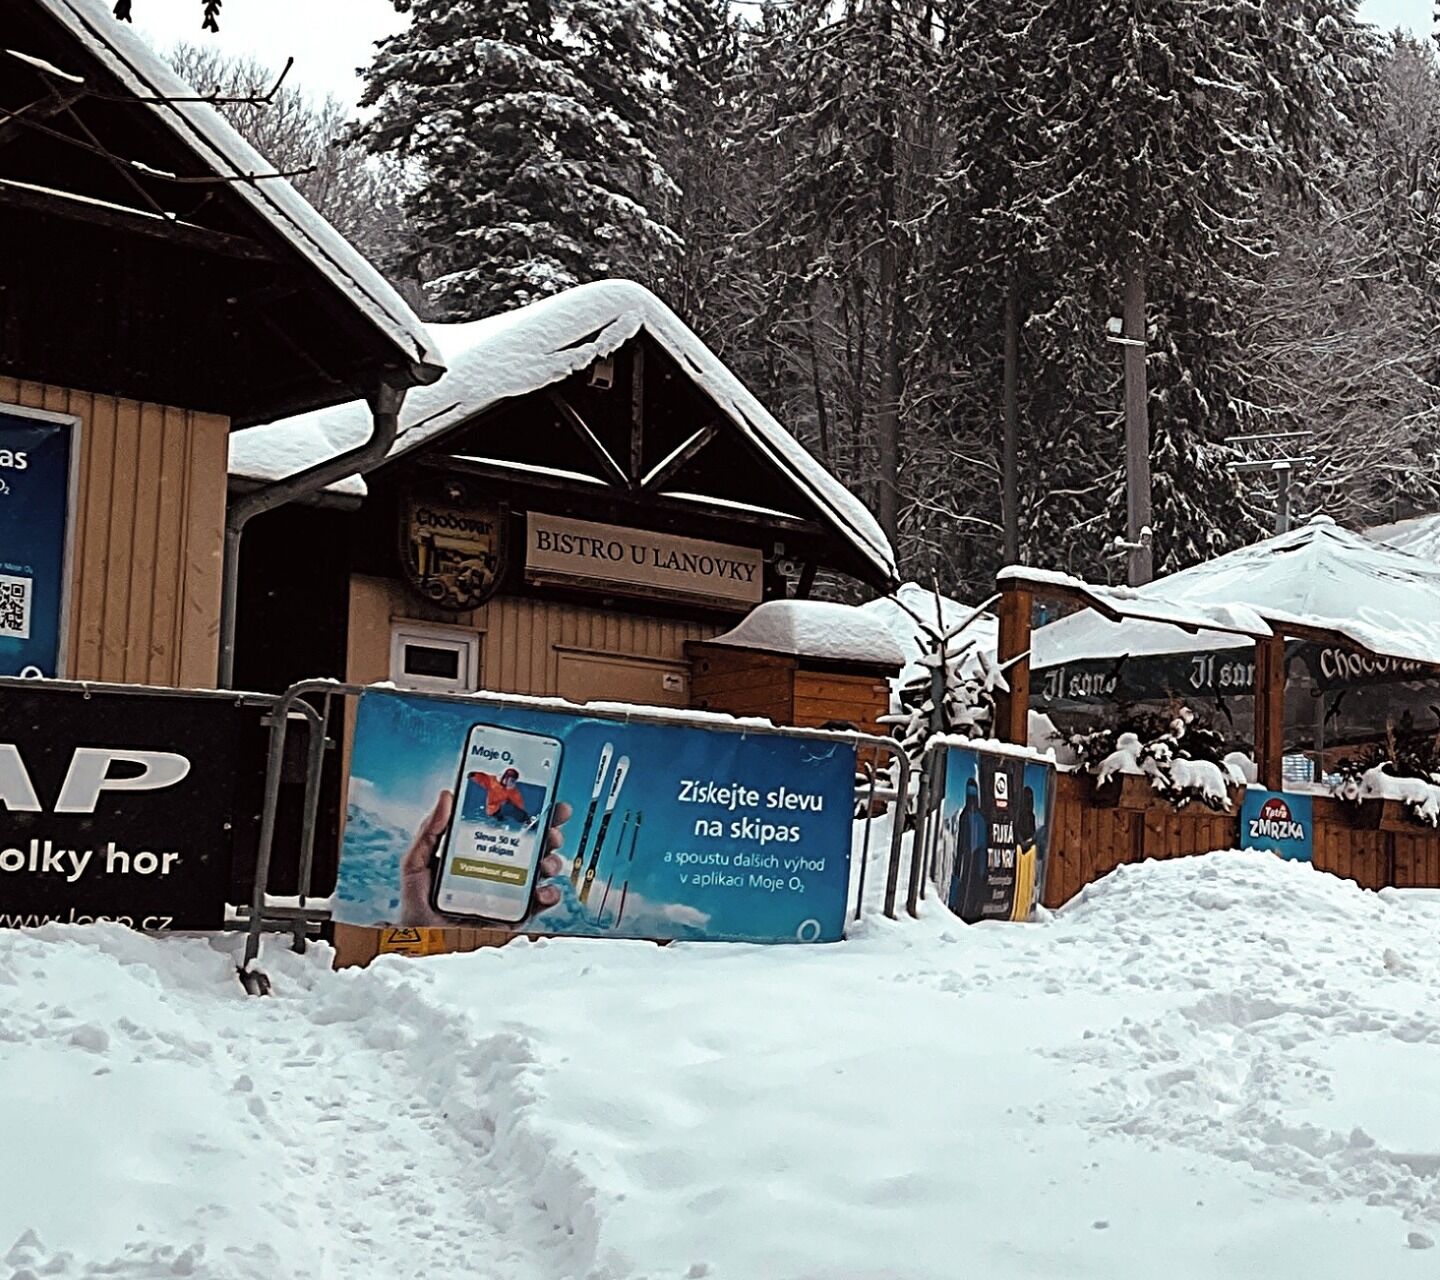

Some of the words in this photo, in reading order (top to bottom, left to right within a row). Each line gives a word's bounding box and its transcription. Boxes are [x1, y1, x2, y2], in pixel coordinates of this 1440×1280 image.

[417, 507, 493, 534] Chodovar
[536, 529, 624, 562] BISTRO
[630, 544, 647, 565] U
[653, 548, 757, 583] LANOVKY
[471, 744, 500, 761] Moje
[678, 779, 760, 810] Získejte
[766, 786, 823, 811] slevu
[694, 819, 722, 837] na
[730, 817, 800, 845] skipas
[1249, 818, 1305, 840] ZMRZKA
[0, 839, 93, 882] olky
[106, 842, 179, 875] hor
[664, 851, 672, 862] a
[675, 852, 729, 866] spoustu
[733, 853, 779, 869] dalších
[784, 857, 825, 872] výhod
[679, 875, 688, 884] v
[692, 871, 744, 888] aplikaci
[749, 875, 784, 892] Moje
